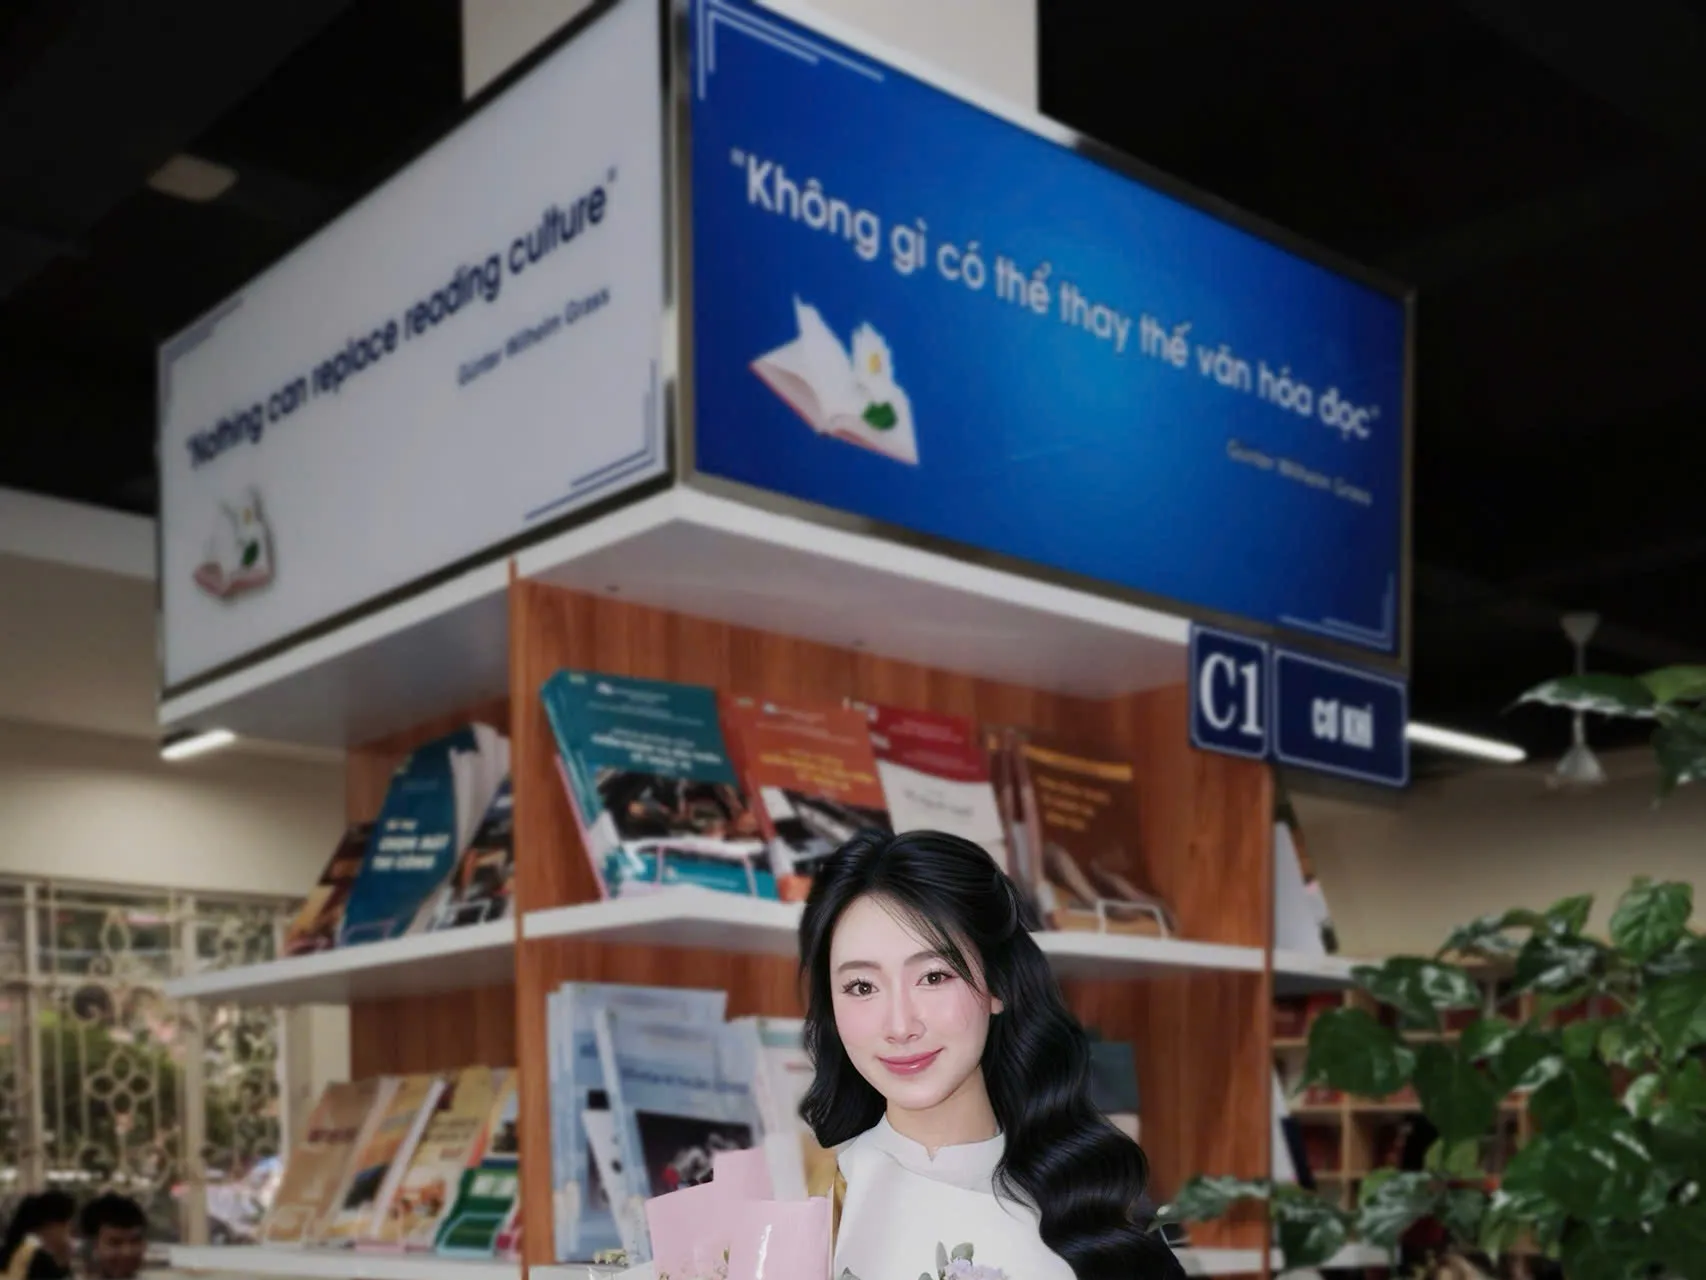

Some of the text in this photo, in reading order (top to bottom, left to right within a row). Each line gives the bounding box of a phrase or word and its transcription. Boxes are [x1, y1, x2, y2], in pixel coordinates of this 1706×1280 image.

[267, 376, 308, 423] can
[312, 319, 398, 396] replace
[404, 253, 501, 340] reading
[730, 147, 880, 261] "Không
[890, 217, 928, 276] gì
[936, 240, 987, 291] có
[995, 254, 1052, 315] thể
[1060, 280, 1131, 353] thay
[1140, 313, 1192, 369] thế
[1197, 344, 1251, 391] văn
[1258, 360, 1313, 416] hóa
[1199, 652, 1264, 735] C1
